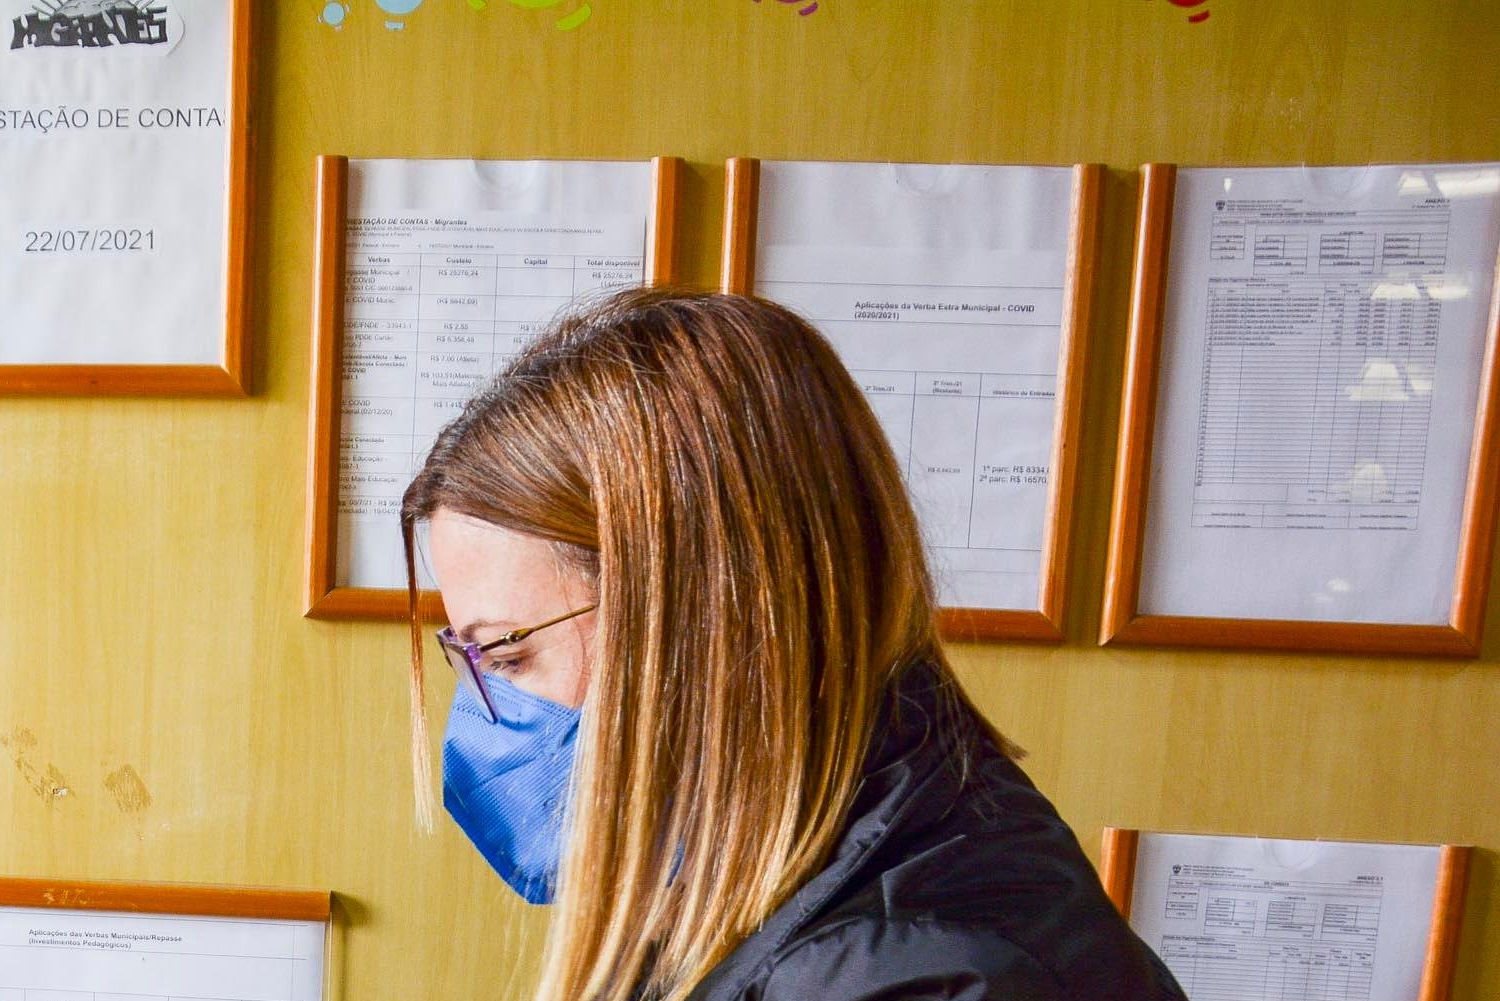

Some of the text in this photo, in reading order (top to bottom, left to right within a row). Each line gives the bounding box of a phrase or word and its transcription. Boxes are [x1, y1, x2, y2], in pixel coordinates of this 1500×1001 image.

[98, 108, 129, 129] DE
[25, 229, 156, 252] 22/07/2021
[961, 304, 1001, 312] Municipal
[1008, 304, 1035, 312] COVID
[29, 929, 68, 938] Aplicações
[84, 931, 109, 939] Verbas
